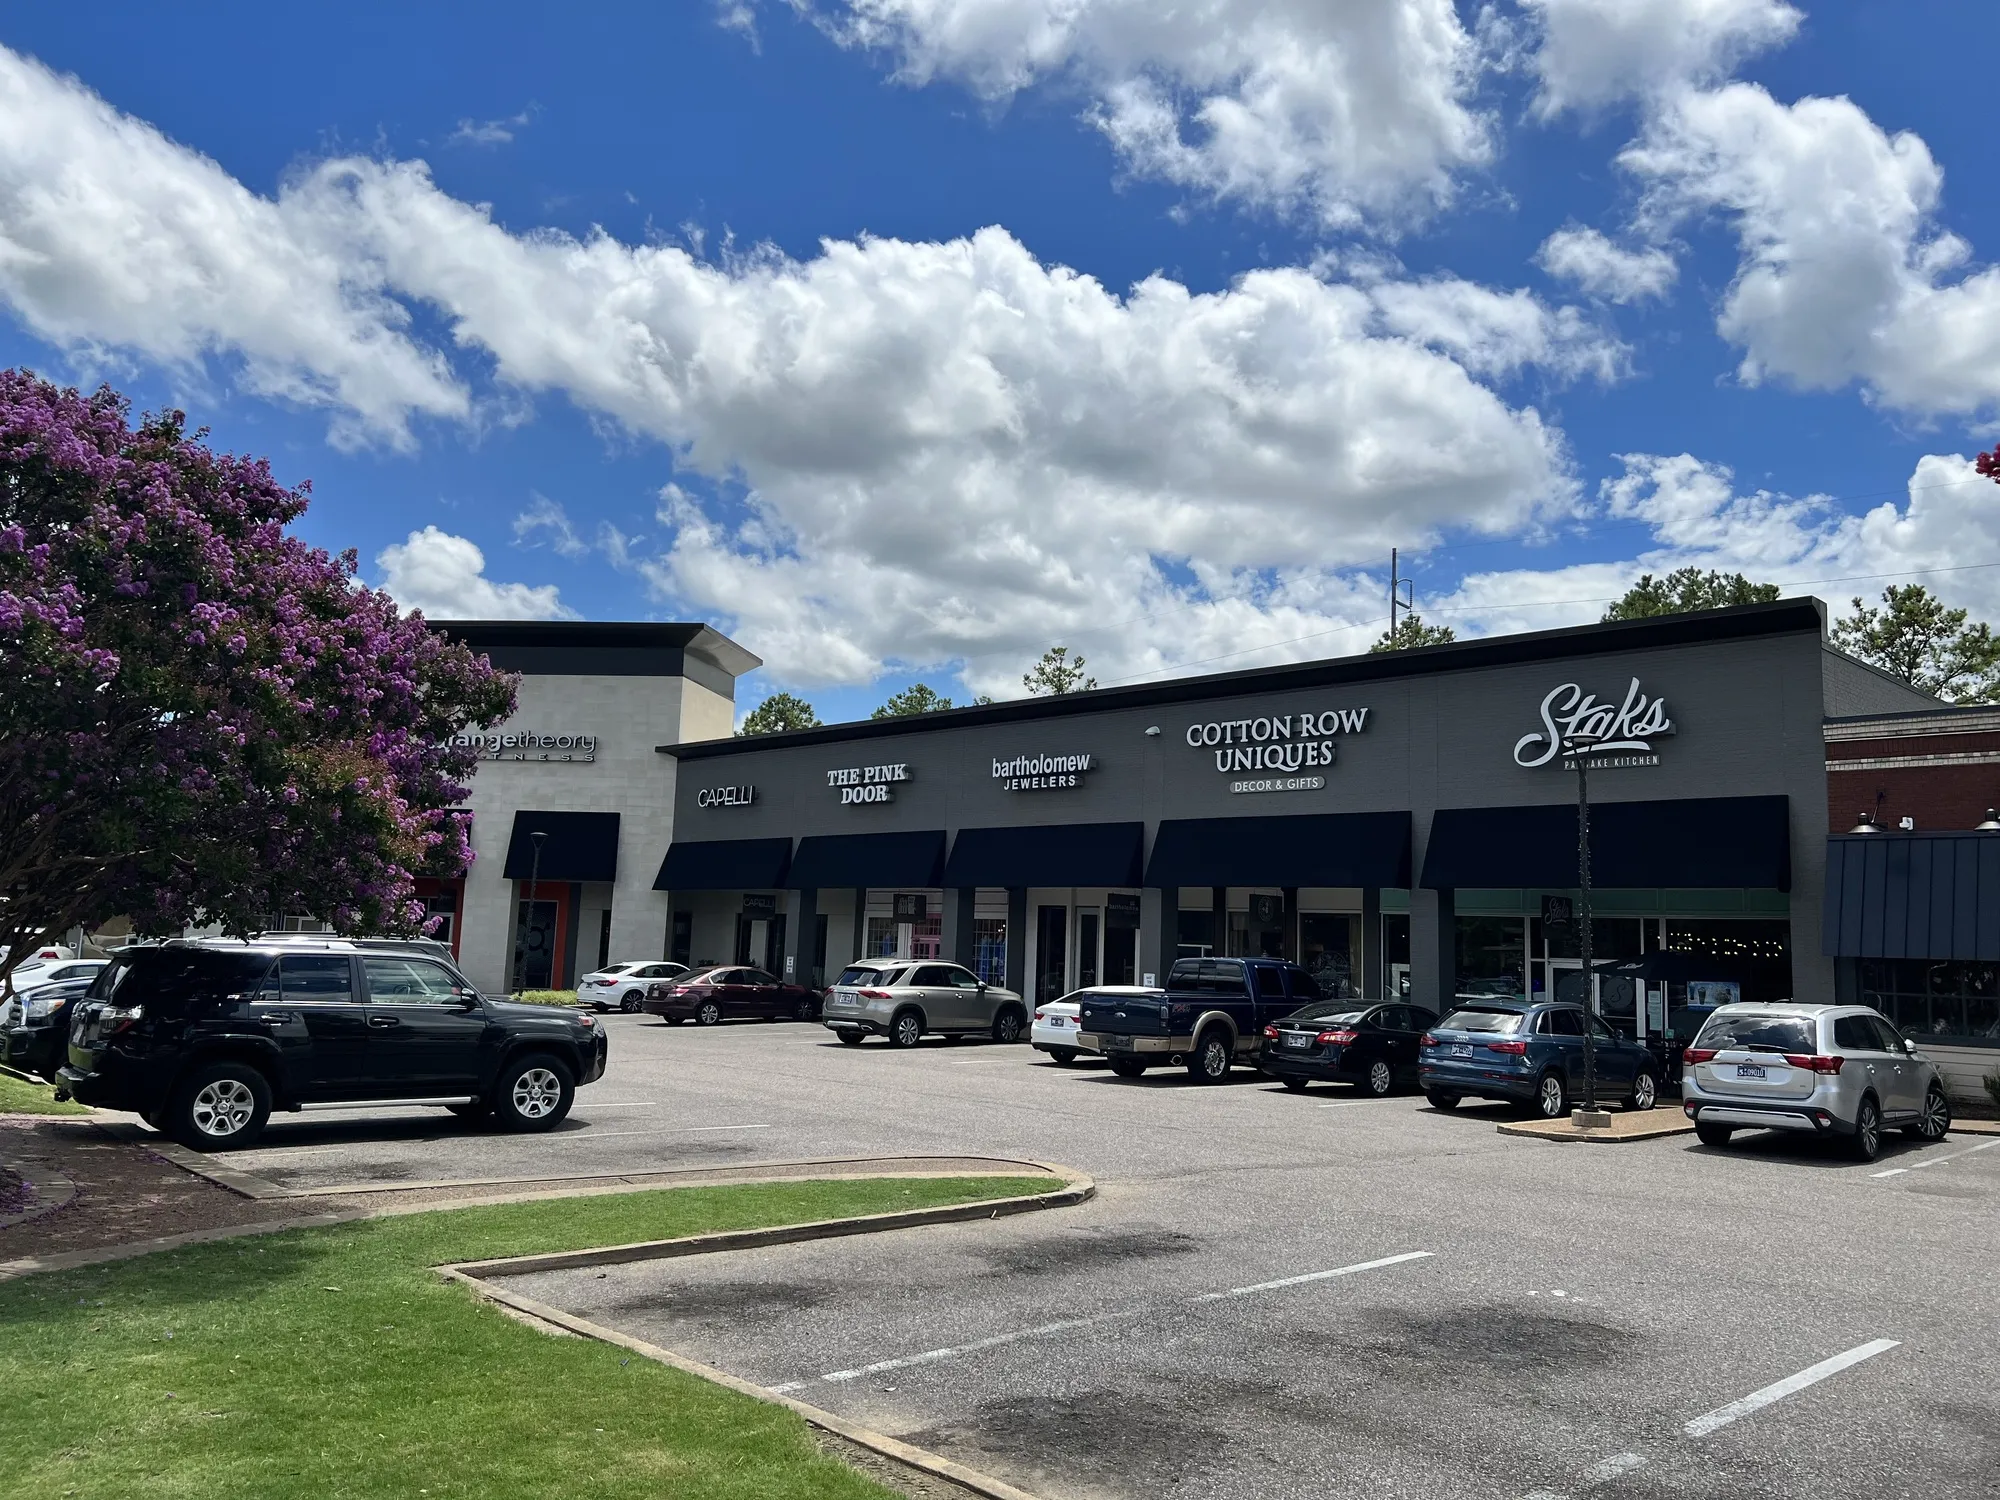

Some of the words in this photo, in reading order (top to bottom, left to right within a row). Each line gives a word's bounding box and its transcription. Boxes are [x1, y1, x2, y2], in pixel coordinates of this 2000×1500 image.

[1186, 714, 1292, 747] COTTON
[1300, 707, 1369, 737] ROW
[1513, 676, 1670, 768] Staks
[430, 730, 598, 752] rangetheory
[491, 752, 595, 762] TNESS
[992, 753, 1091, 778] bartholomew
[1215, 740, 1333, 773] UNIQUES
[1614, 756, 1658, 766] KITCHEN
[827, 768, 860, 786] THE
[863, 763, 906, 783] PINK
[1003, 775, 1076, 790] JEWELERS
[1234, 779, 1272, 792] DECOR
[1275, 778, 1283, 790] &
[1286, 776, 1319, 789] GIFTS
[698, 785, 753, 807] CAPELLI
[840, 785, 888, 804] DOOR
[743, 898, 774, 908] CAPELLI
[1544, 897, 1570, 925] Staks
